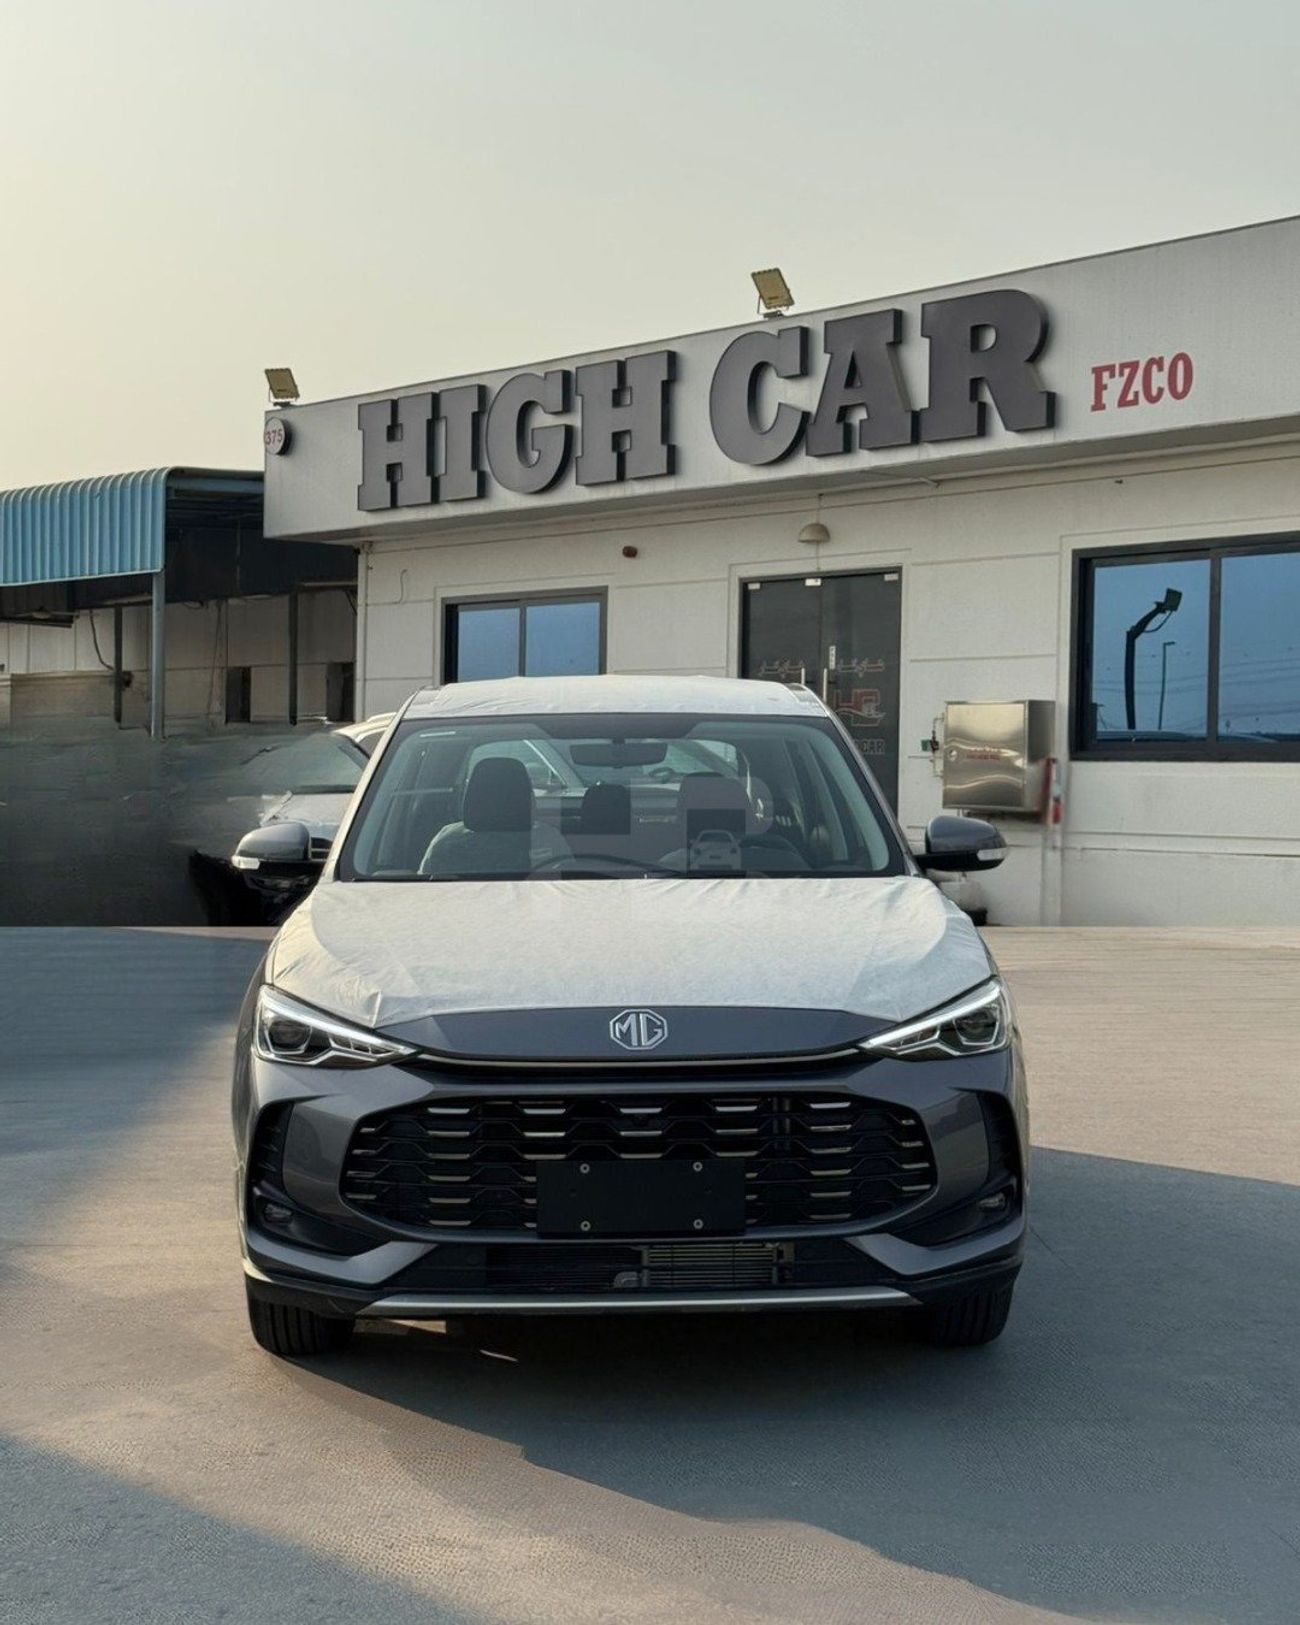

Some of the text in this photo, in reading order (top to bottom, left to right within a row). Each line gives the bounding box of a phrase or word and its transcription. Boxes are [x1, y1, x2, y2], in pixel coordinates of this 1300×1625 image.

[357, 288, 1057, 512] HIGH CAR
[1090, 351, 1194, 412] FZCO
[265, 428, 283, 445] 375
[614, 1012, 664, 1047] MG
